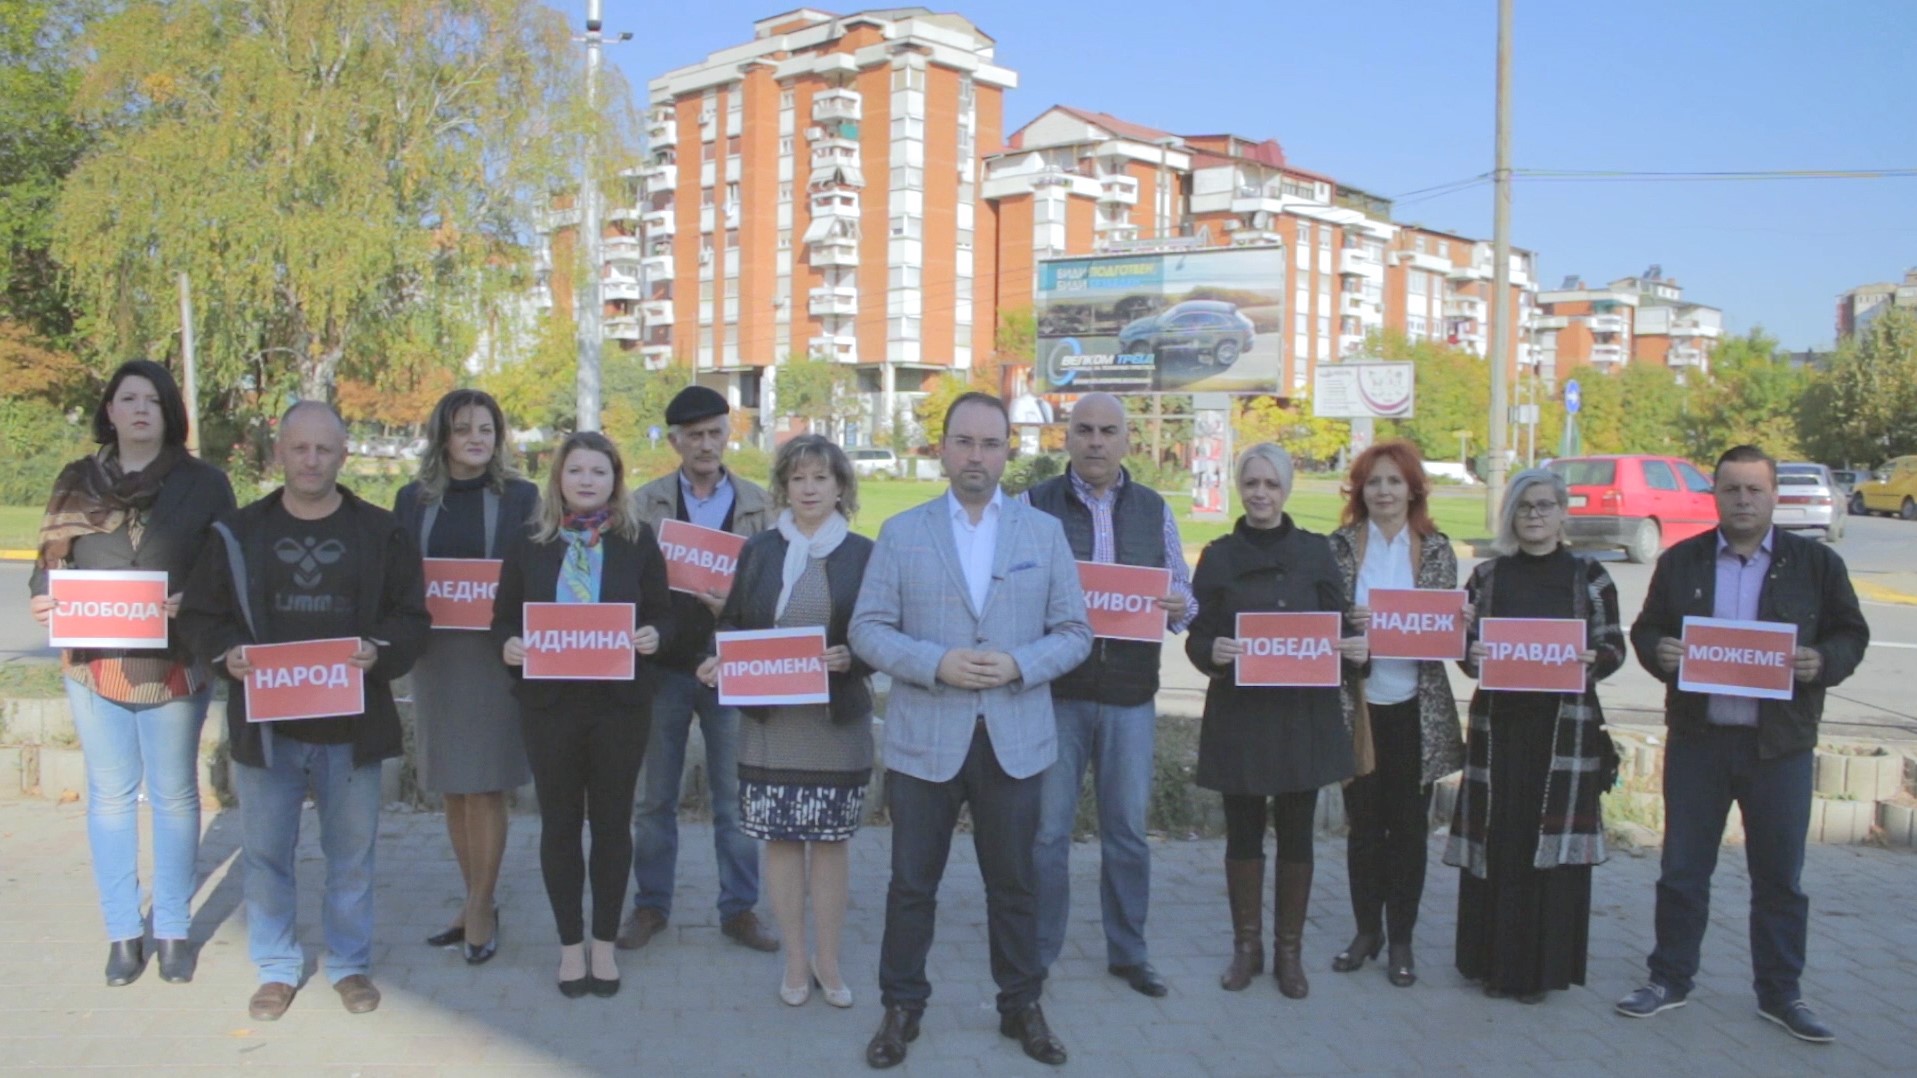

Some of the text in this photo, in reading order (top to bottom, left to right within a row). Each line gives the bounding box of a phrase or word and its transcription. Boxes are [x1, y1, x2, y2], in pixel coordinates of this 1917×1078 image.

[425, 580, 500, 603] АЕДНО
[55, 601, 160, 621] СЛОБОДА
[1371, 612, 1455, 635] НАДЕЖ
[523, 629, 631, 653] ИДНИНА
[1238, 637, 1333, 660] ПОБЕДА
[1484, 642, 1577, 666] ПРАВДА
[1687, 644, 1787, 667] МОЖЕМЕ
[255, 663, 349, 689] НАРОД
[723, 656, 822, 677] ПРОМЕНА
